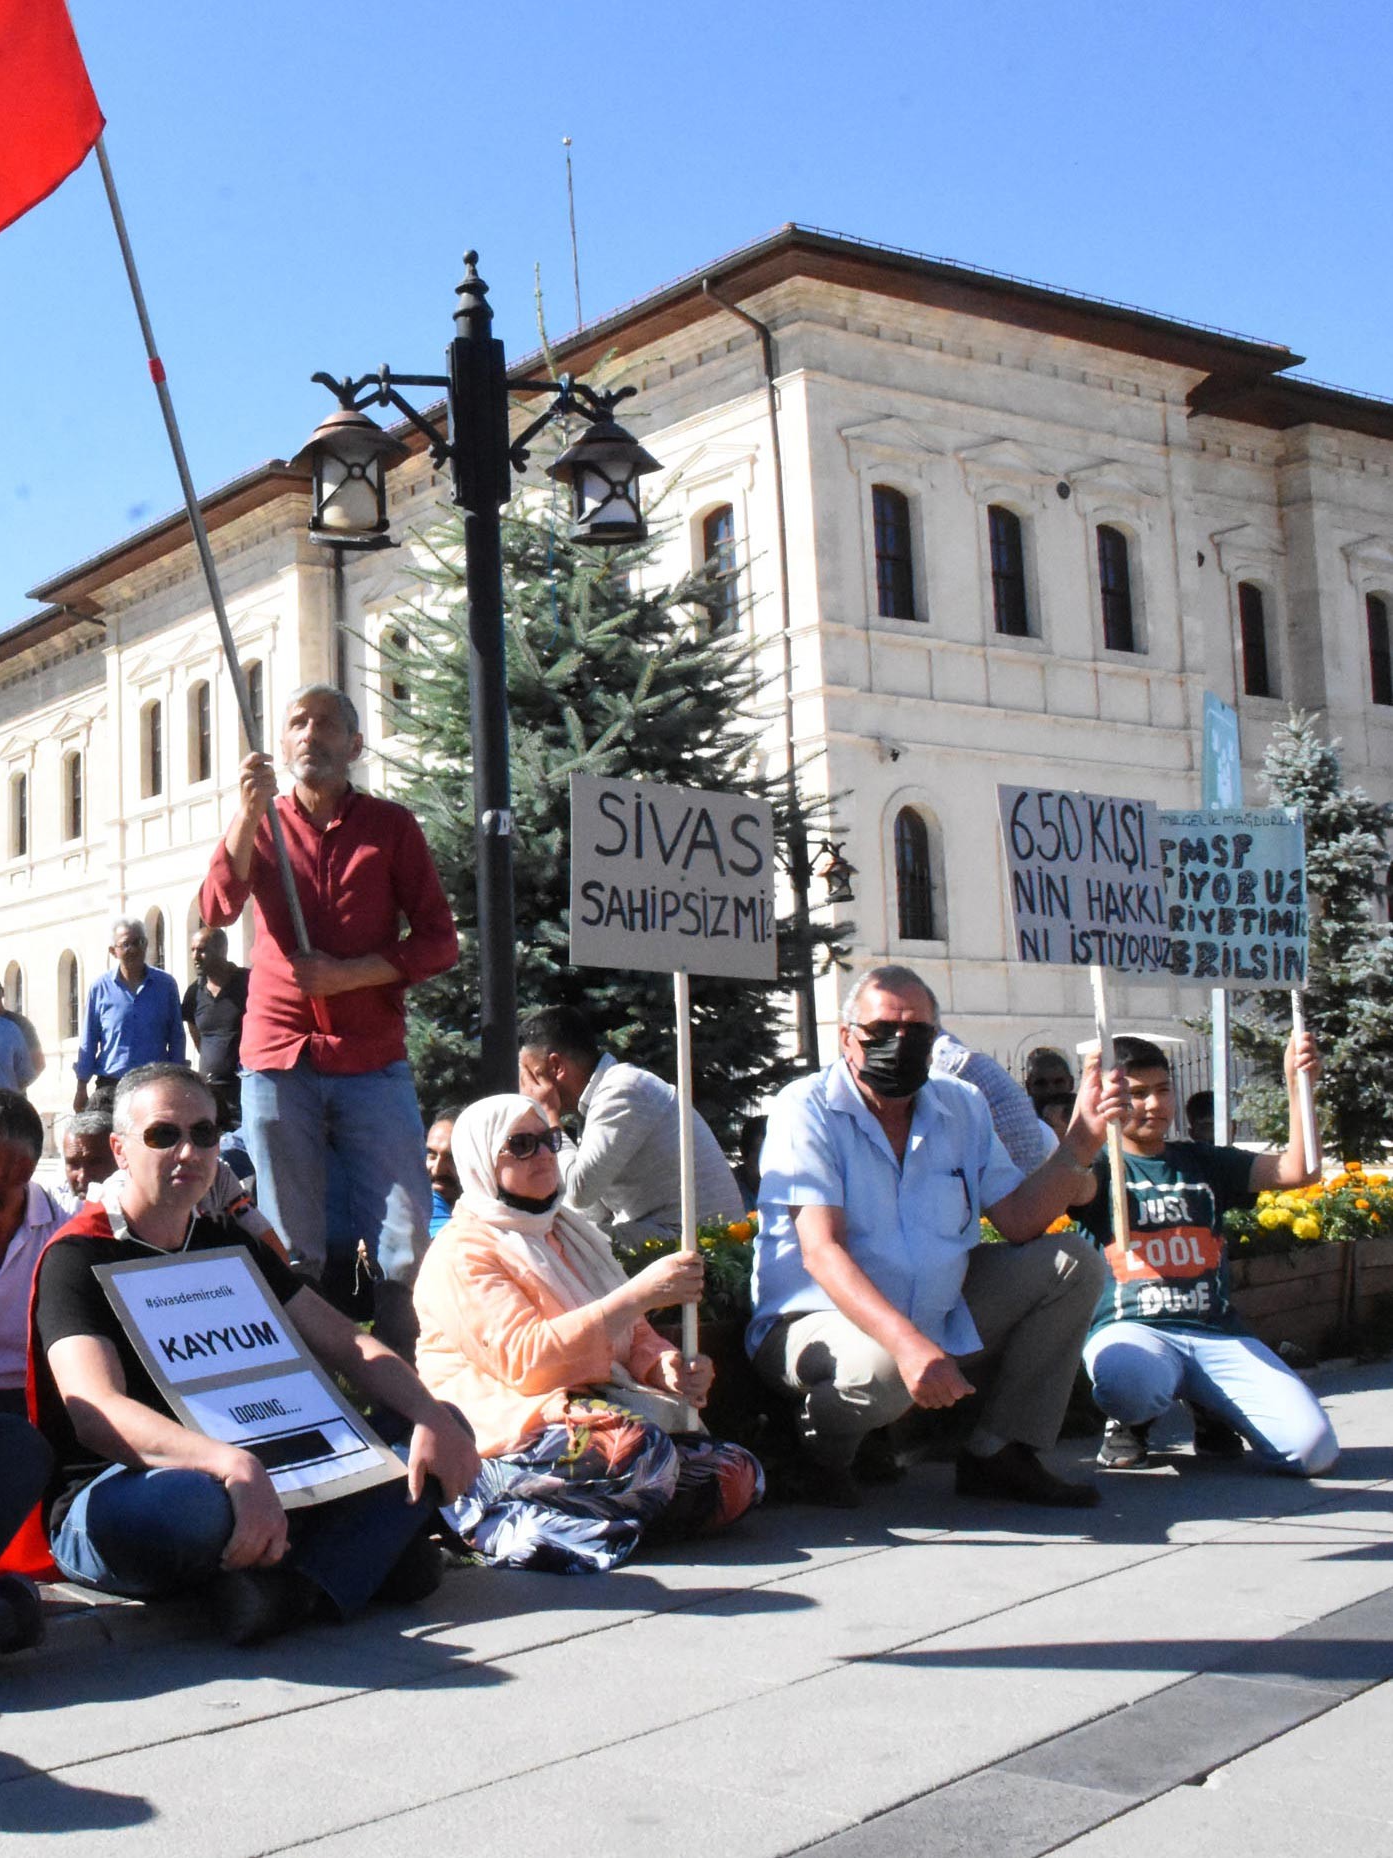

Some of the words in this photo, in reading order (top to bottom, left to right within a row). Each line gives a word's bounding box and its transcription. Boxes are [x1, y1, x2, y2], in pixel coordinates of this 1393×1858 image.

[594, 791, 763, 877] SİVAS
[1011, 791, 1082, 862] 650
[1013, 865, 1071, 920] NİN
[158, 1320, 280, 1363] KAYYUM
